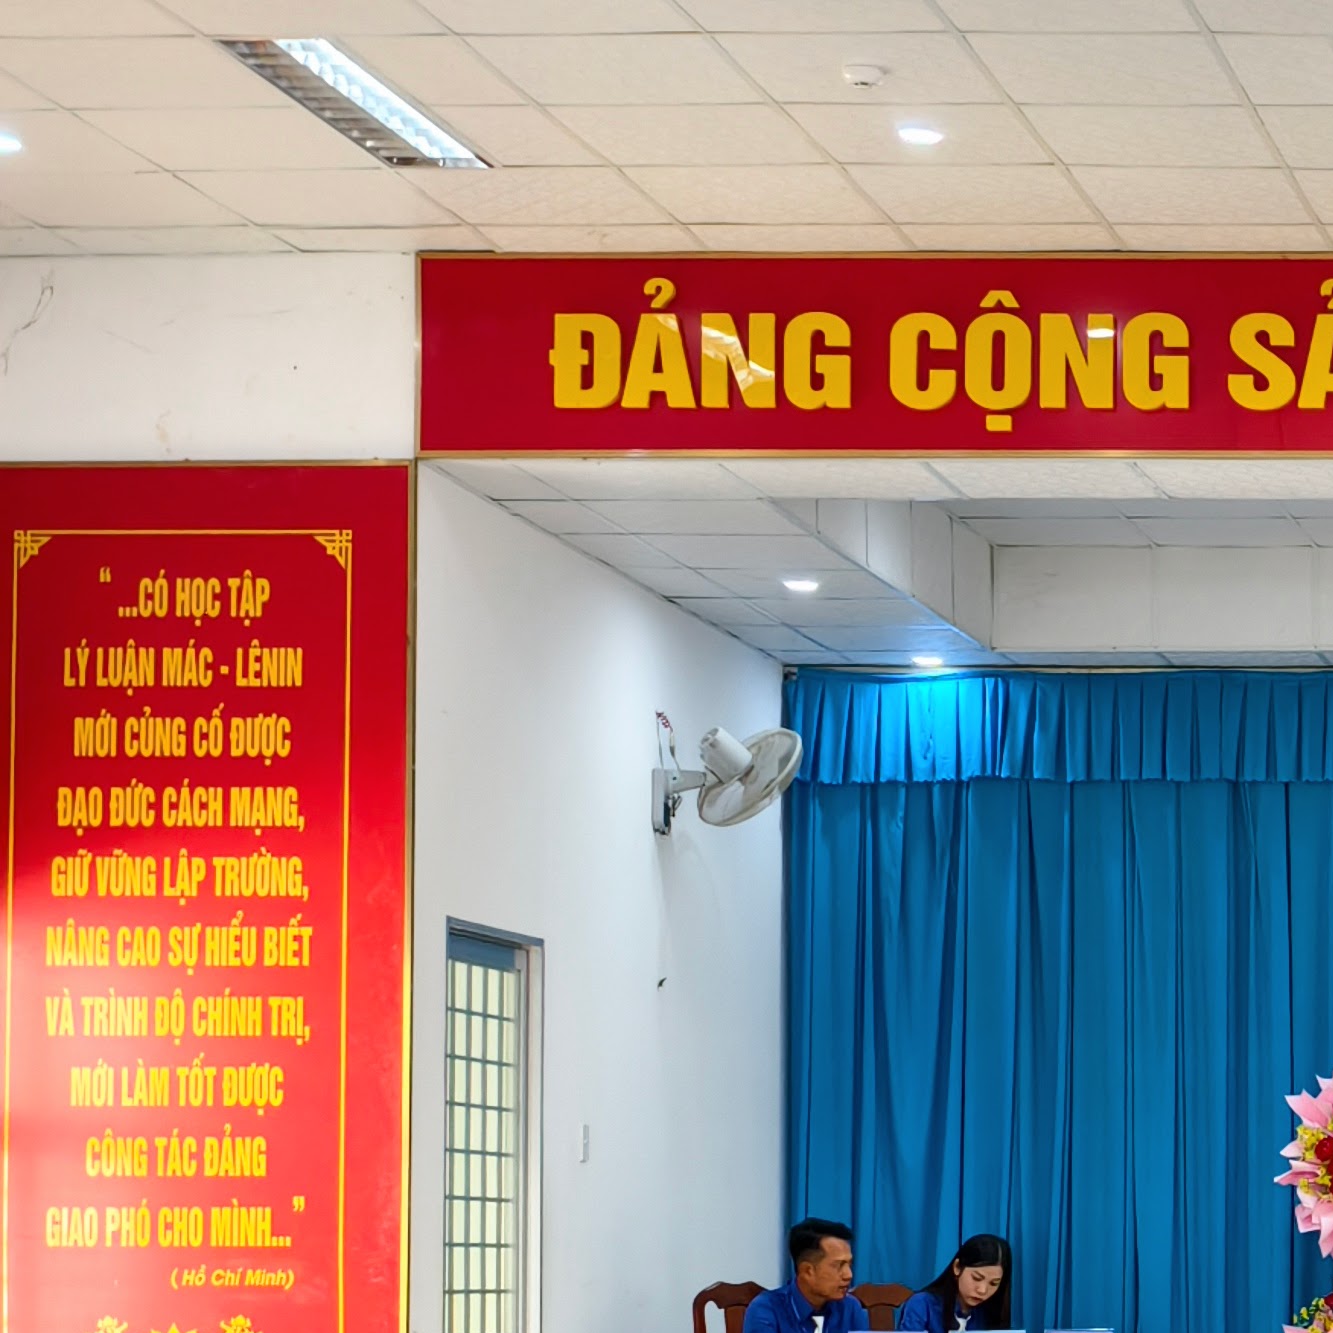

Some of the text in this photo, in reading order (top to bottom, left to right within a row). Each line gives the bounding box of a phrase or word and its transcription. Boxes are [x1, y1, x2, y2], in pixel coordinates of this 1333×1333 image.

[549, 278, 852, 410] ĐẢNG
[890, 290, 1190, 431] CỘNG
[176, 578, 220, 626] HỌC
[228, 570, 270, 626] TẬP
[64, 640, 302, 696] LÝ LUẬN MÁC LÊNIN
[74, 703, 291, 766] MỚI CỦNG CỐ ĐƯỢC
[57, 779, 304, 836] ĐẠO ĐỨC CÁCH MẠNG,
[51, 847, 309, 905] GIỮ VỮNG LẬP TRƯỜNG,
[46, 911, 313, 976] NÂNG CAO SỰ HIỂU BIẾT
[46, 988, 310, 1046] VÀ TRÌNH ĐỘ CHÍNH TRỊ,
[70, 1053, 284, 1116] MỚI LÀM TỐT ĐƯỢC
[86, 1123, 267, 1177] CÔNG TÁC ĐẢNG
[45, 1207, 98, 1248] GIAO
[104, 1199, 152, 1248] PHÓ
[157, 1207, 203, 1248] CHO
